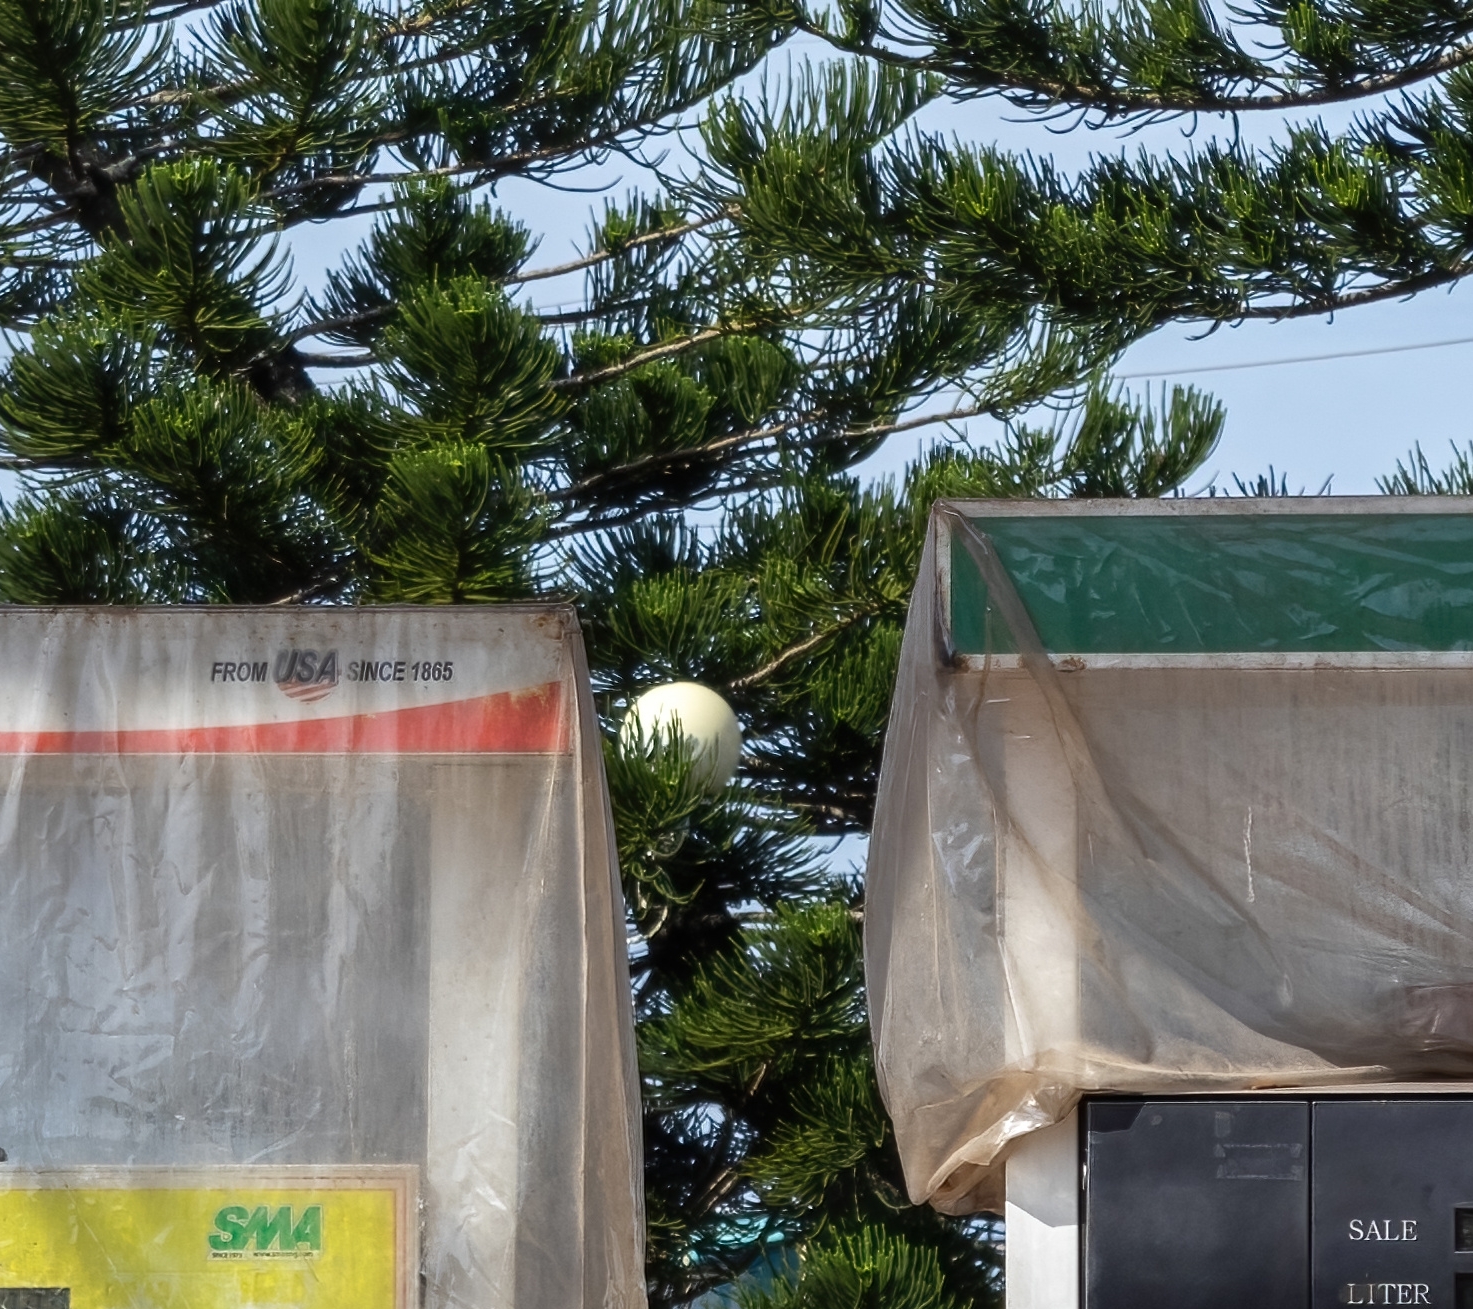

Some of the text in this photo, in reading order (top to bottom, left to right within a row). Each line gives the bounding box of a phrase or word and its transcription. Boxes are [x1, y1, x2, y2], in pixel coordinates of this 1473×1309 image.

[211, 650, 454, 684] FROM USA SINCE 1865
[208, 1206, 321, 1251] SMA
[1348, 1219, 1418, 1242] SALE
[1347, 1283, 1432, 1306] LITER
